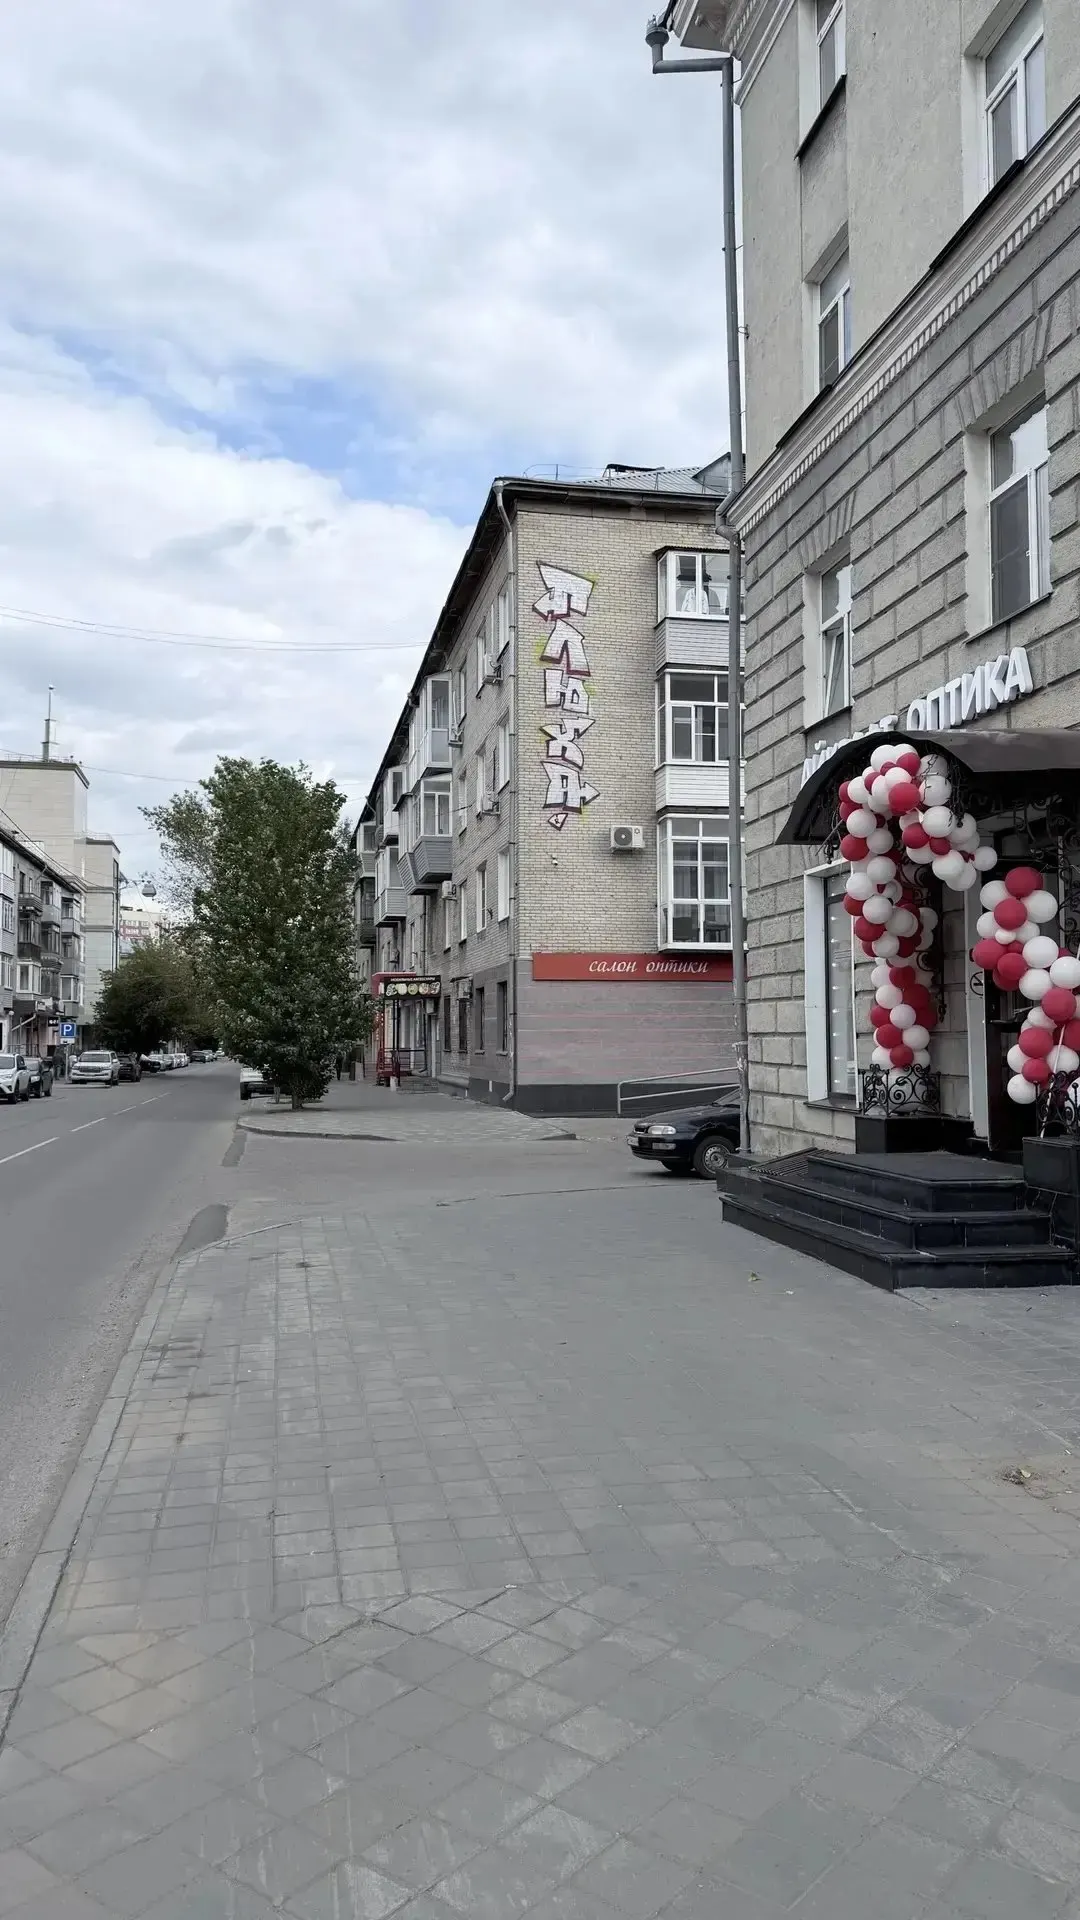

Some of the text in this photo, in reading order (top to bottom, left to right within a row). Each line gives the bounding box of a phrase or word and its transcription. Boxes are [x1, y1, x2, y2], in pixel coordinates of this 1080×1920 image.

[907, 646, 1034, 731] ОПТИКА
[588, 959, 709, 973] салон оптики
[64, 1024, 72, 1036] P
